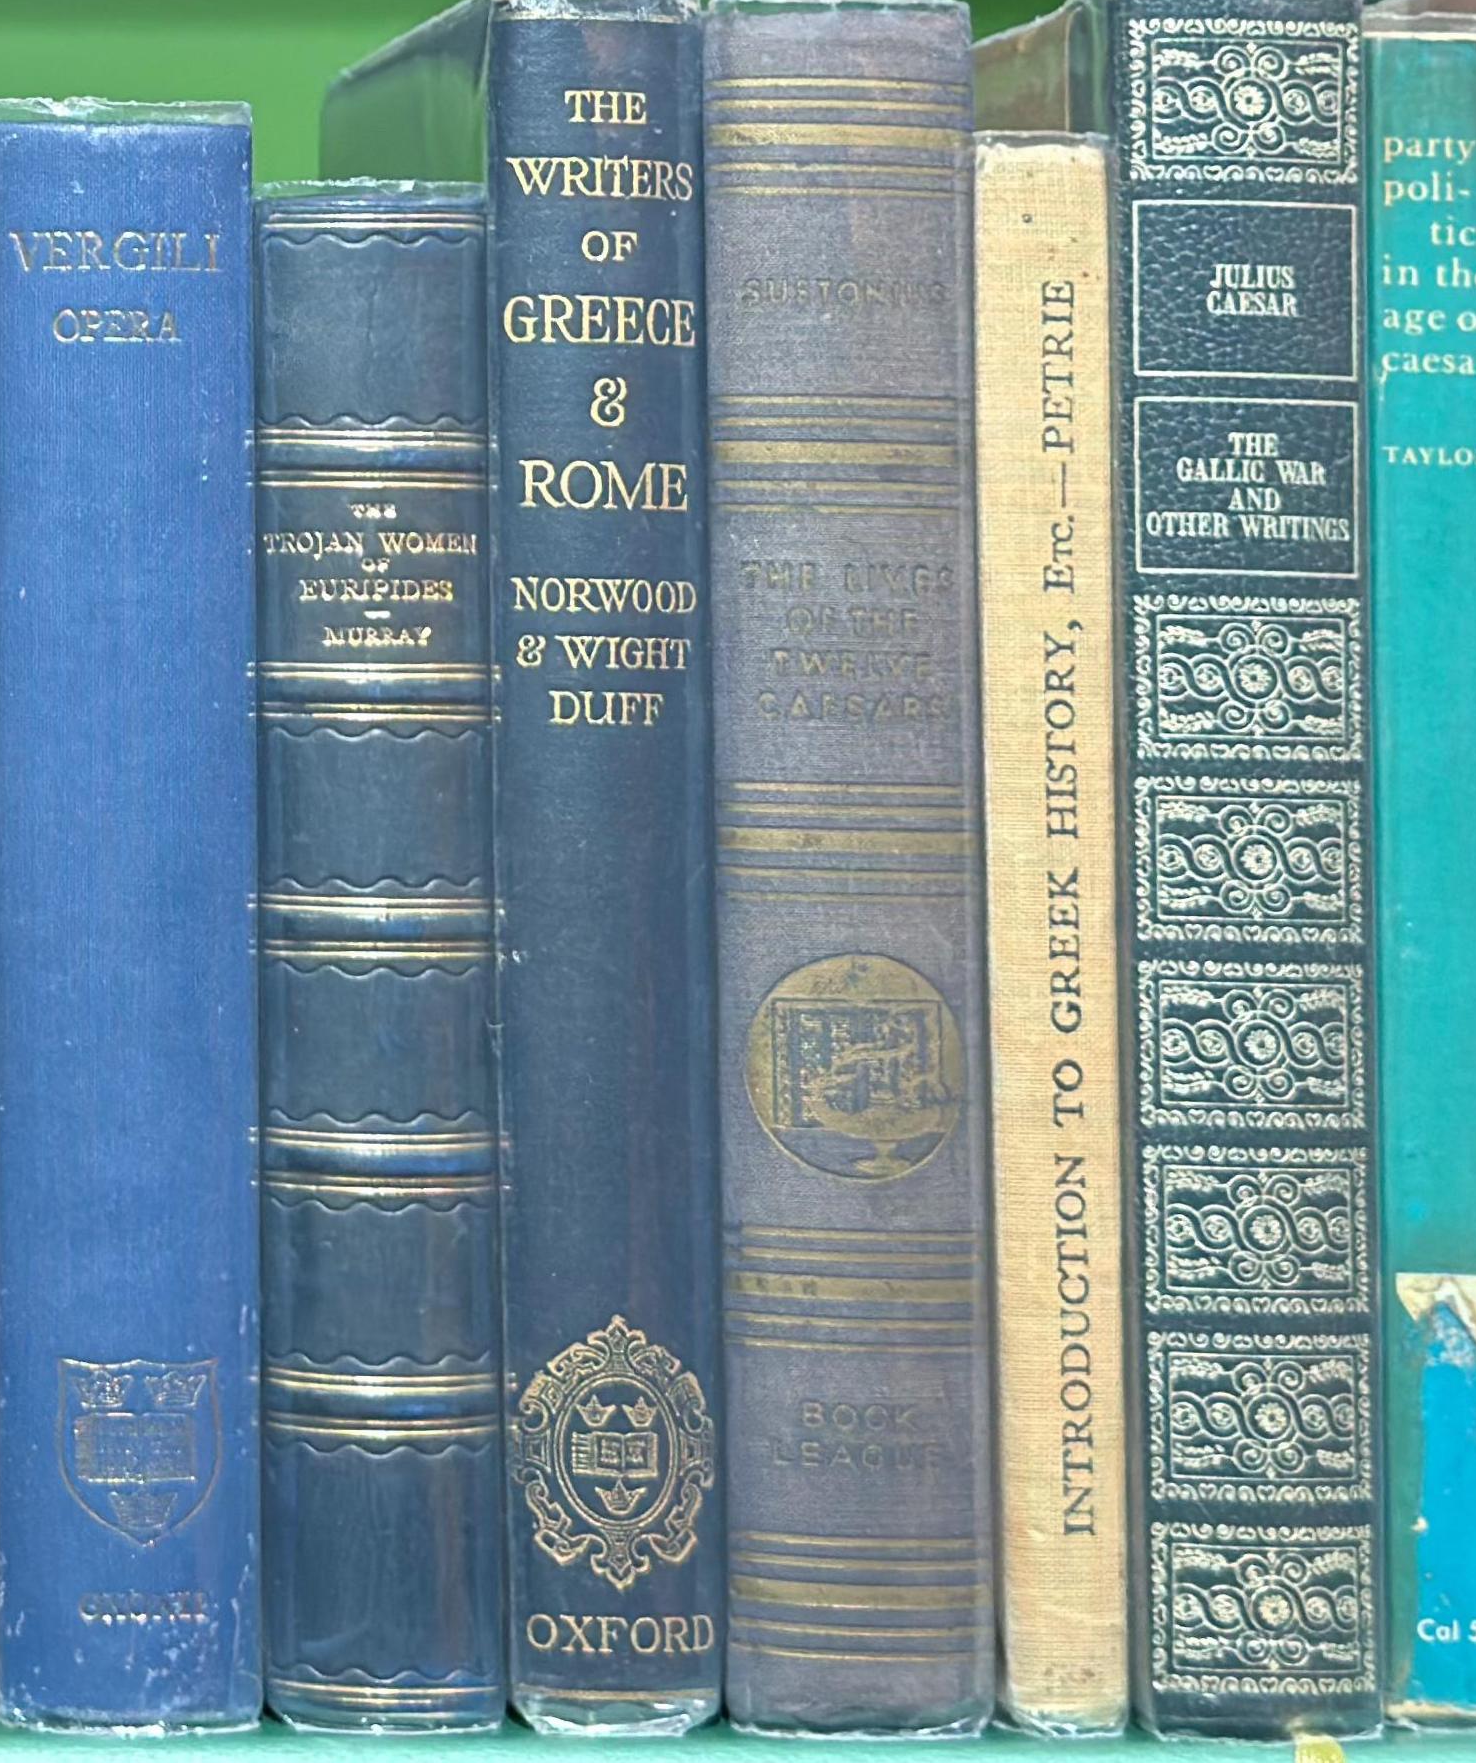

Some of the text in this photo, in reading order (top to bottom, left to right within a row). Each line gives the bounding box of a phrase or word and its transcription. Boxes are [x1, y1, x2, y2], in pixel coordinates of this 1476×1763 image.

[564, 90, 647, 125] THE
[1383, 135, 1476, 165] party
[505, 154, 693, 201] WRITERS
[1383, 171, 1471, 206] poli-
[9, 231, 222, 271] VERGILI
[581, 230, 637, 262] OF
[1210, 263, 1296, 288] JULIUS
[1382, 254, 1419, 287] in
[1206, 291, 1298, 317] CAESAR
[53, 309, 182, 343] OPERA
[503, 294, 696, 347] GREECE
[1383, 307, 1446, 336] age
[590, 377, 627, 428] &
[1228, 432, 1279, 458] THE
[518, 459, 688, 512] ROME
[1176, 457, 1327, 486] GALLIC WAR
[347, 503, 397, 519] THE
[1228, 487, 1282, 512] AND
[1145, 511, 1351, 542] OTHER WRITINGS
[262, 531, 478, 561] TROJAN WOMEN
[361, 558, 391, 573] OF
[740, 560, 816, 590] THE
[298, 578, 454, 602] EURIPIDES
[510, 577, 697, 614] NORWOOD
[322, 626, 432, 647] MURRAY
[786, 607, 918, 636] OF THE
[515, 634, 691, 670] & WIGHT
[770, 648, 931, 677] TWELVE
[549, 691, 665, 726] DUFF
[757, 689, 946, 721] CAESARS
[1043, 619, 1084, 840] HISTORY,
[1047, 868, 1083, 1035] GREEK
[1053, 1058, 1084, 1128] TO
[1054, 1153, 1096, 1538] INTRODUCTION
[802, 1401, 919, 1431] BOOK
[526, 1613, 714, 1654] OXFORD
[1417, 1619, 1460, 1644] Cal
